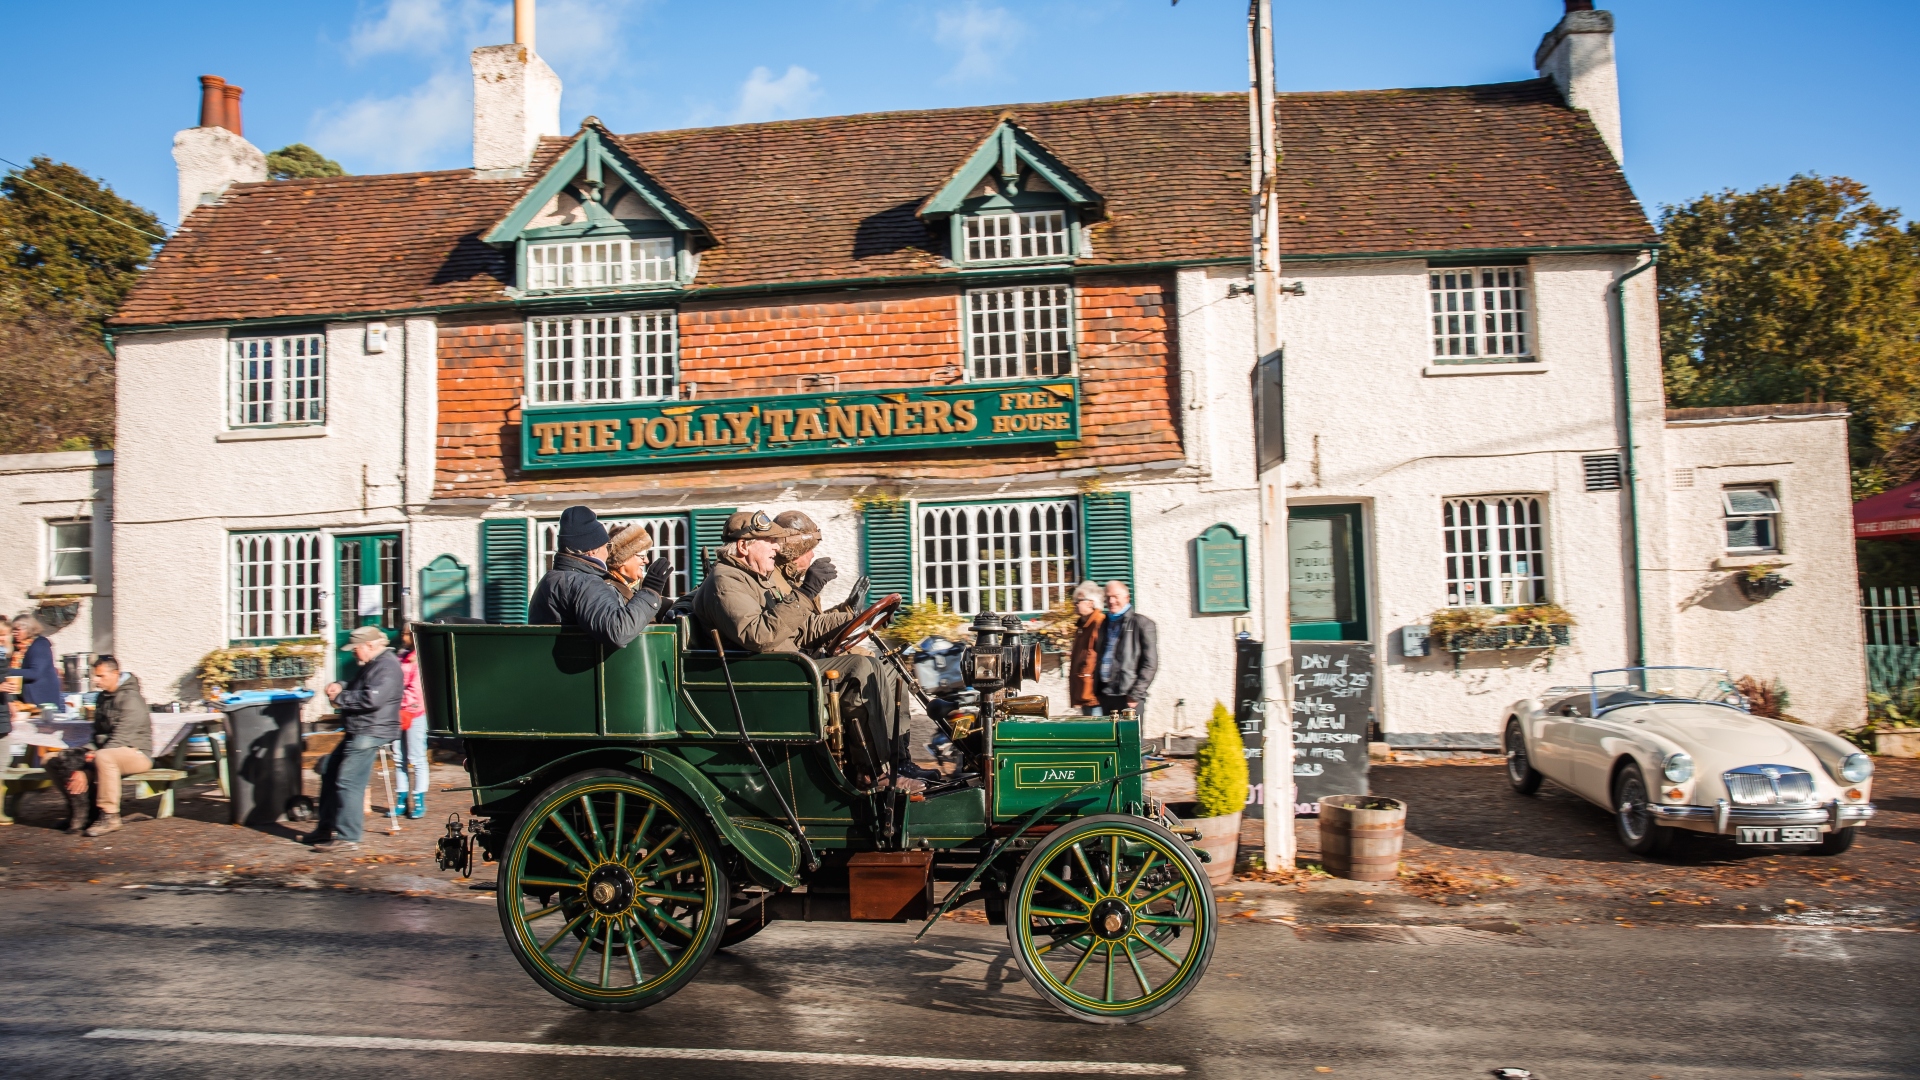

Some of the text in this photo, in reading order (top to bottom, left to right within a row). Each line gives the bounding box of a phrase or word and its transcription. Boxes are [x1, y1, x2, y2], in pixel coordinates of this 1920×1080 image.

[532, 399, 978, 455] THE JOLLY TANNERS
[991, 412, 1070, 433] HOUSE
[1294, 556, 1333, 568] PUBLI
[1304, 571, 1331, 583] BAR
[1300, 653, 1332, 670] DAY
[1306, 713, 1346, 730] NEW
[1040, 769, 1075, 782] JANE
[1742, 828, 1778, 842] YYT
